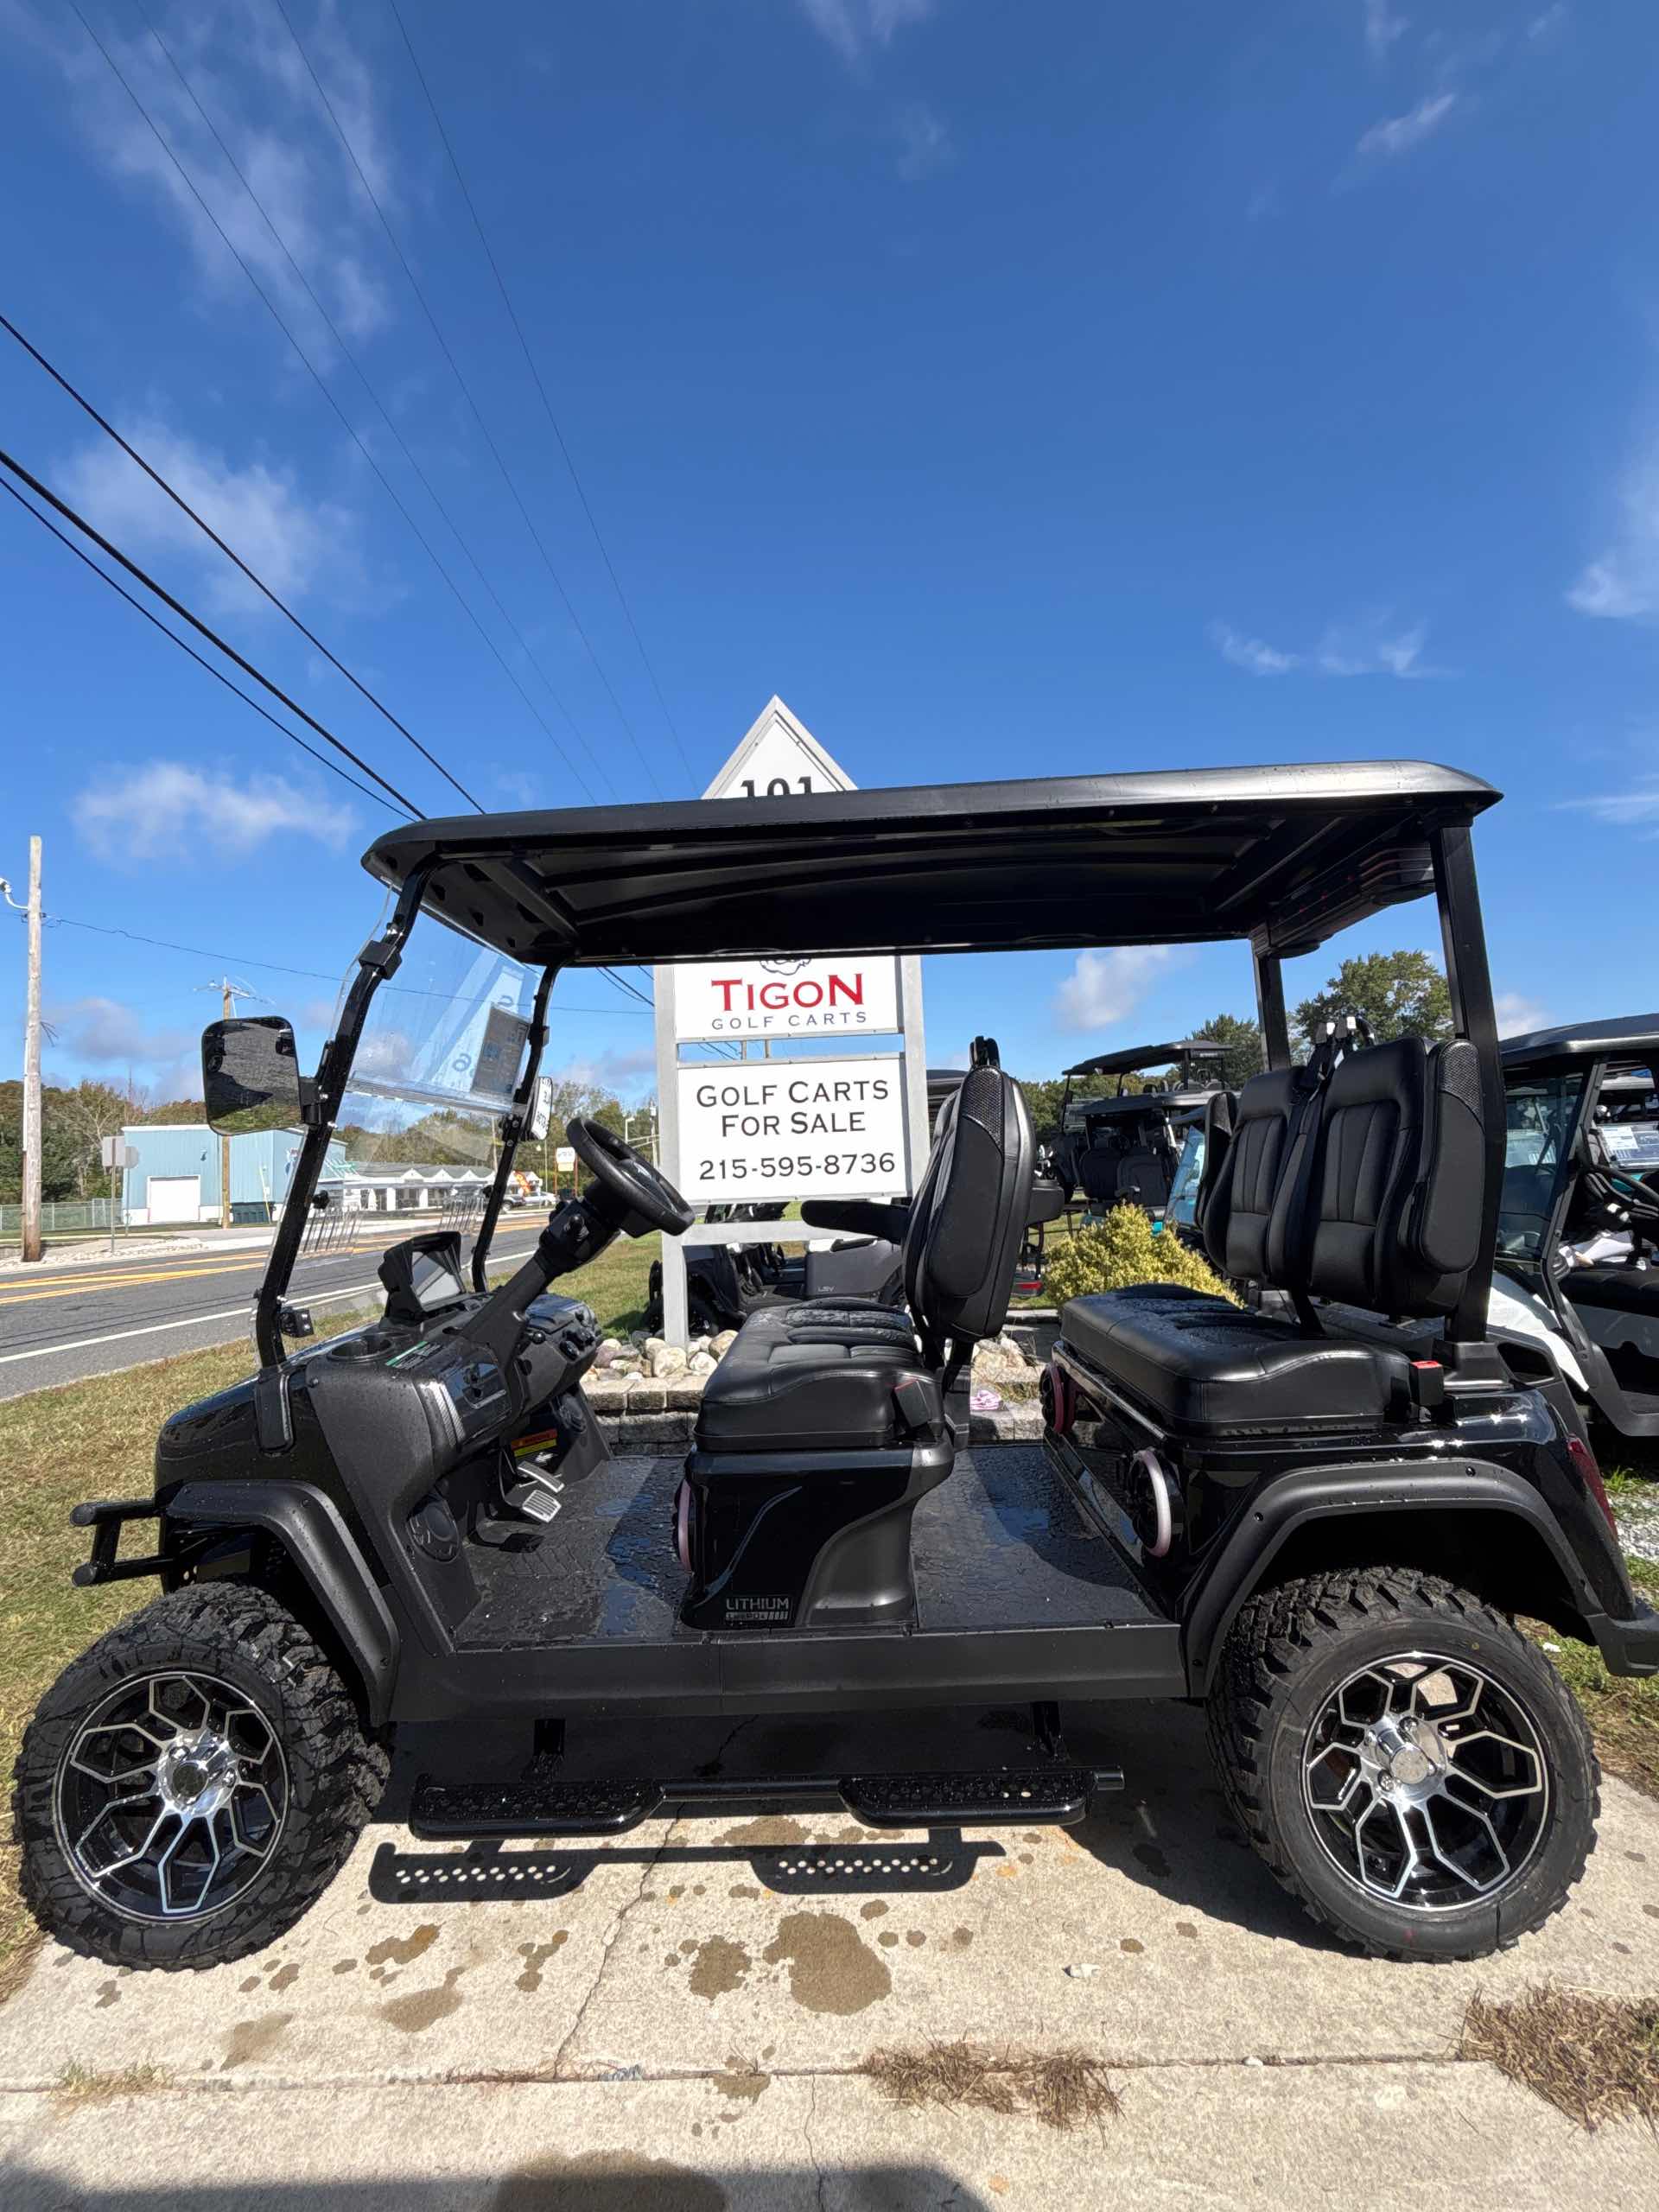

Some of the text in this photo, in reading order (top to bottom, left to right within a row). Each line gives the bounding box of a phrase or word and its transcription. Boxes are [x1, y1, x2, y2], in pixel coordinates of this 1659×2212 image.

[711, 973, 864, 1011] TIGON
[711, 1012, 867, 1030] GOLF CARTS
[696, 1080, 888, 1108] GOLF CARTS
[721, 1111, 867, 1137] FOR SALE
[699, 1152, 895, 1180] 215-595-8736
[726, 1598, 789, 1611] LITHIUM
